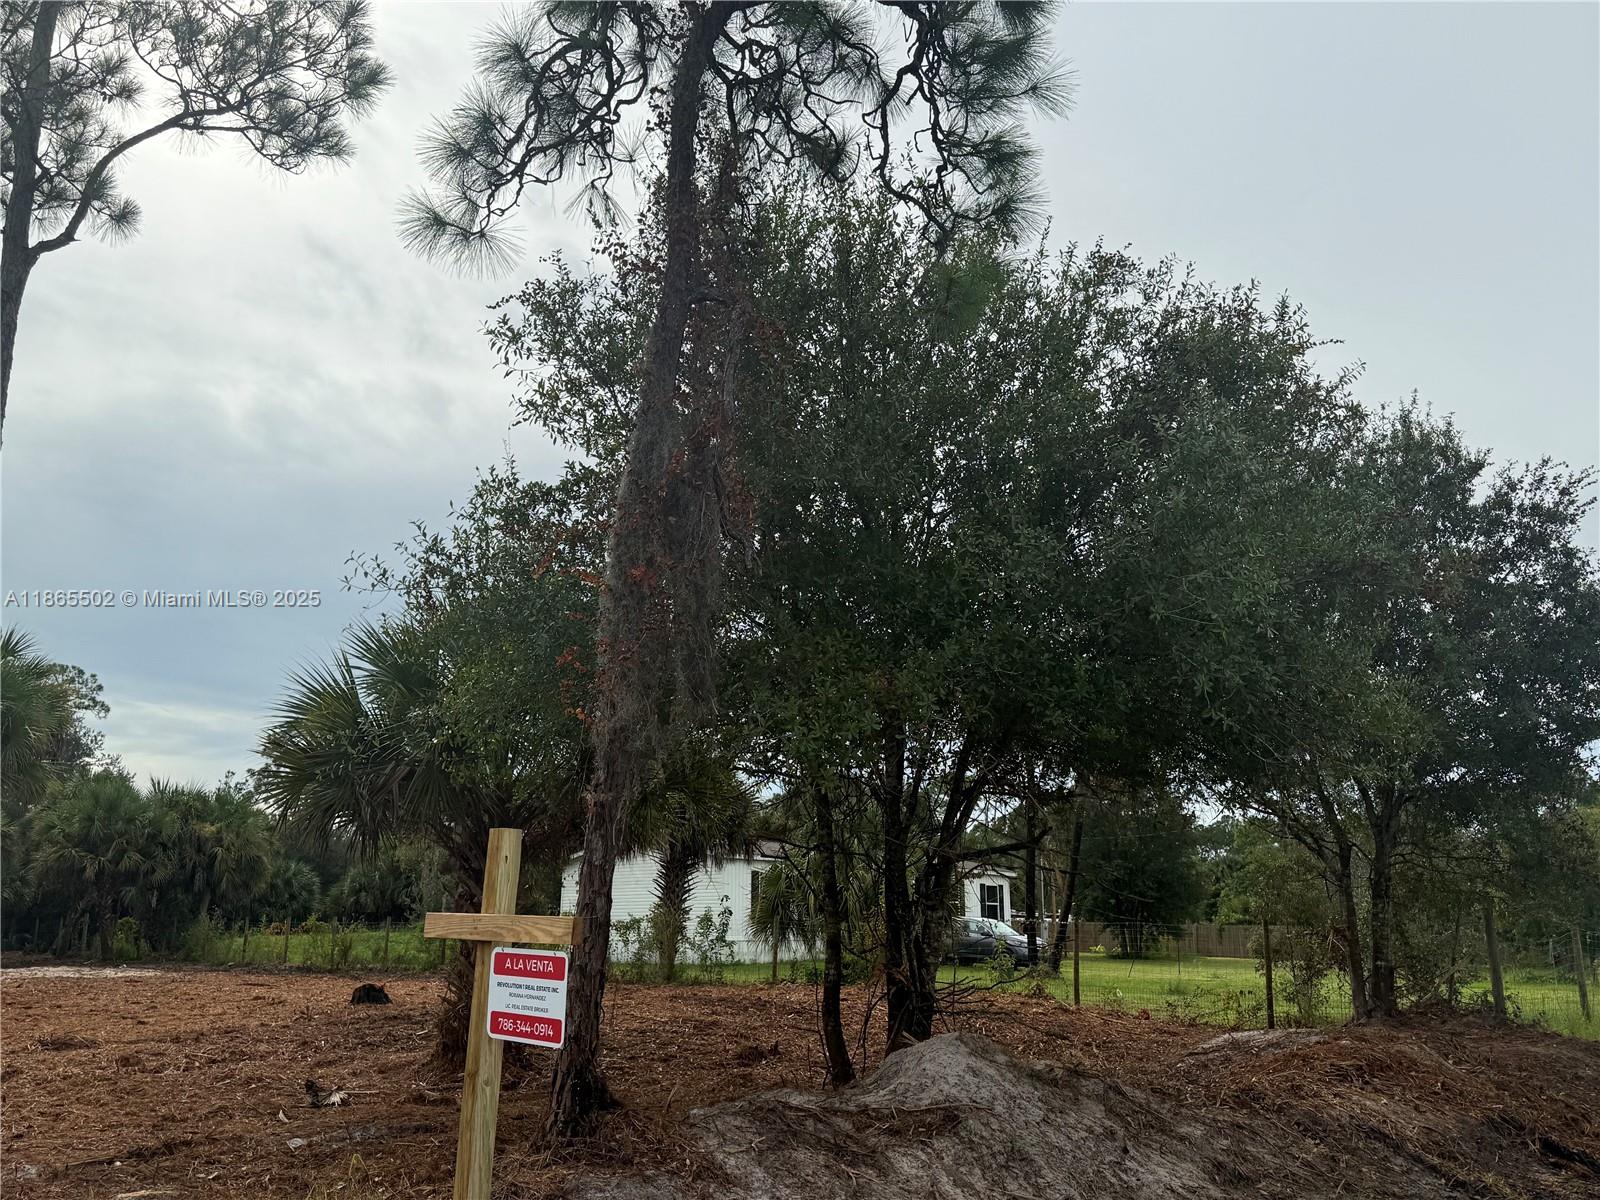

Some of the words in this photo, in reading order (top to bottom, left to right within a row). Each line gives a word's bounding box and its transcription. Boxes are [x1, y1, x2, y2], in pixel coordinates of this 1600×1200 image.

[505, 958, 512, 969] A
[513, 958, 524, 970] LA
[526, 960, 554, 973] VENTA
[497, 981, 522, 990] REVOLUTION
[498, 1018, 553, 1037] 786-344-0914
